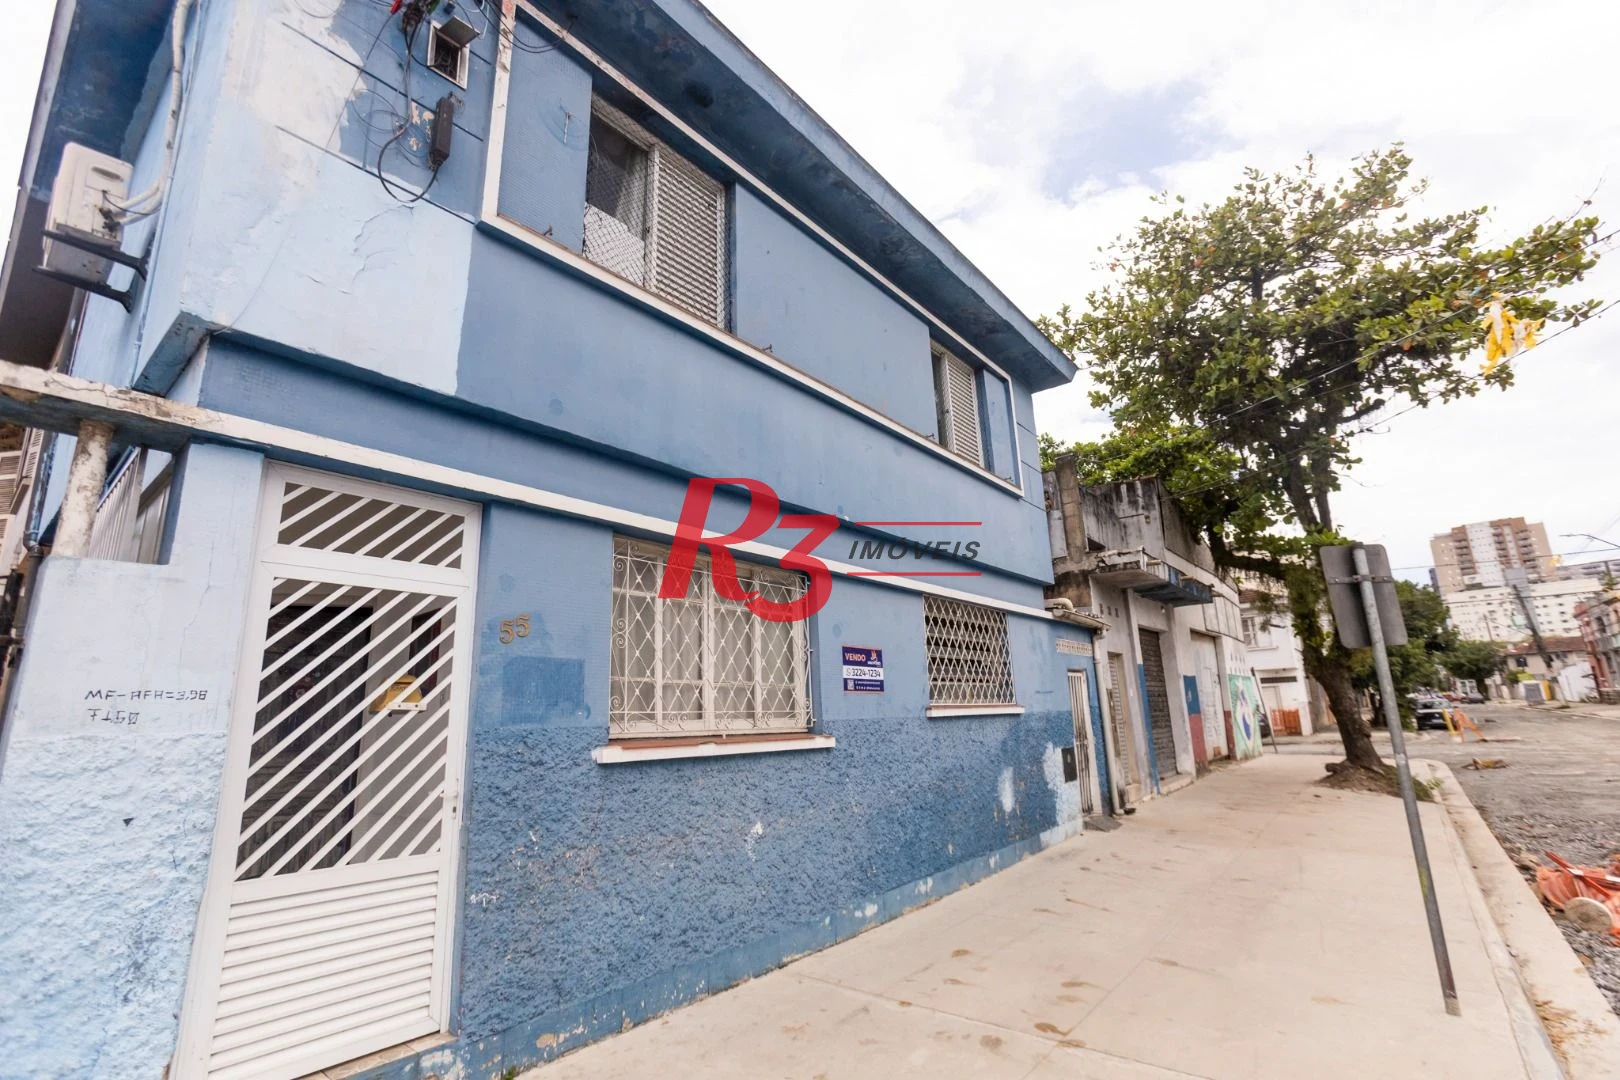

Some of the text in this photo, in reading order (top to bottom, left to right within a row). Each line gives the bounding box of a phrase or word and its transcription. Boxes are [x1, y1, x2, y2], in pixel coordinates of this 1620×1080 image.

[499, 614, 529, 645] 55
[845, 653, 865, 661] VENDO
[852, 668, 880, 677] 3224-1234
